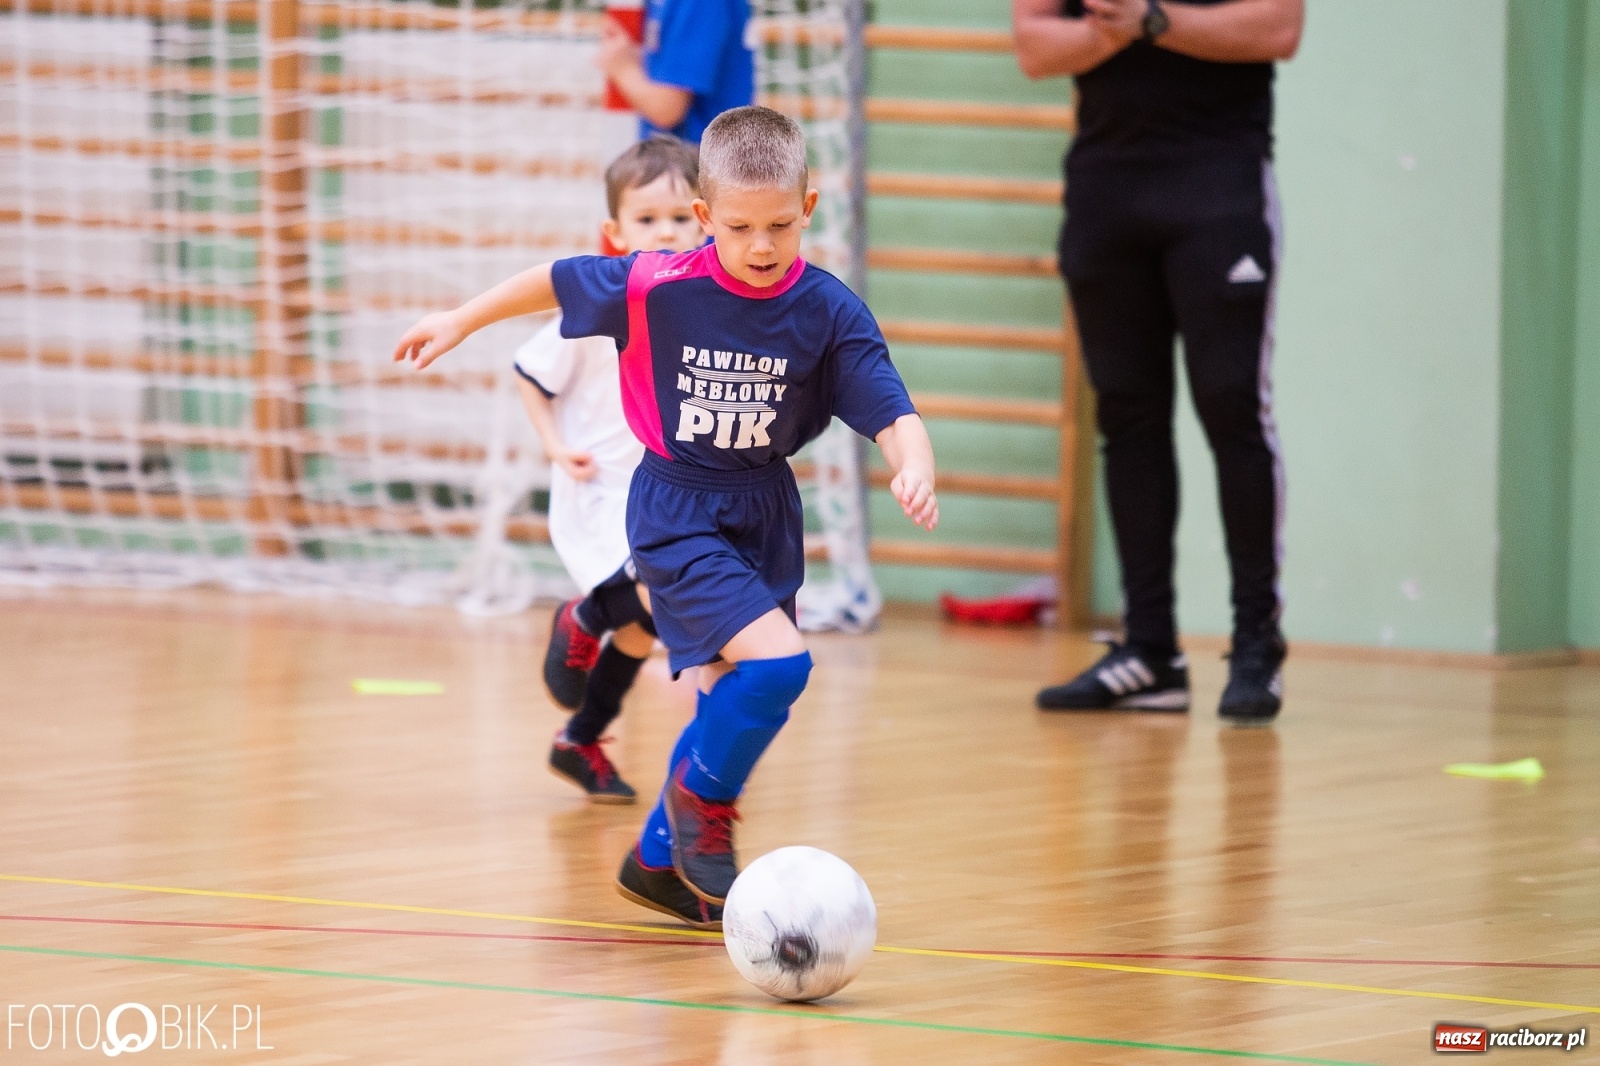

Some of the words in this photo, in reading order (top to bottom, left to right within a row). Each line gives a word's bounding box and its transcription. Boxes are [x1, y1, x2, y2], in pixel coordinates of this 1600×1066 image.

[682, 345, 788, 376] PAWILON
[677, 372, 787, 402] MEBLOWY
[675, 401, 777, 449] PIK
